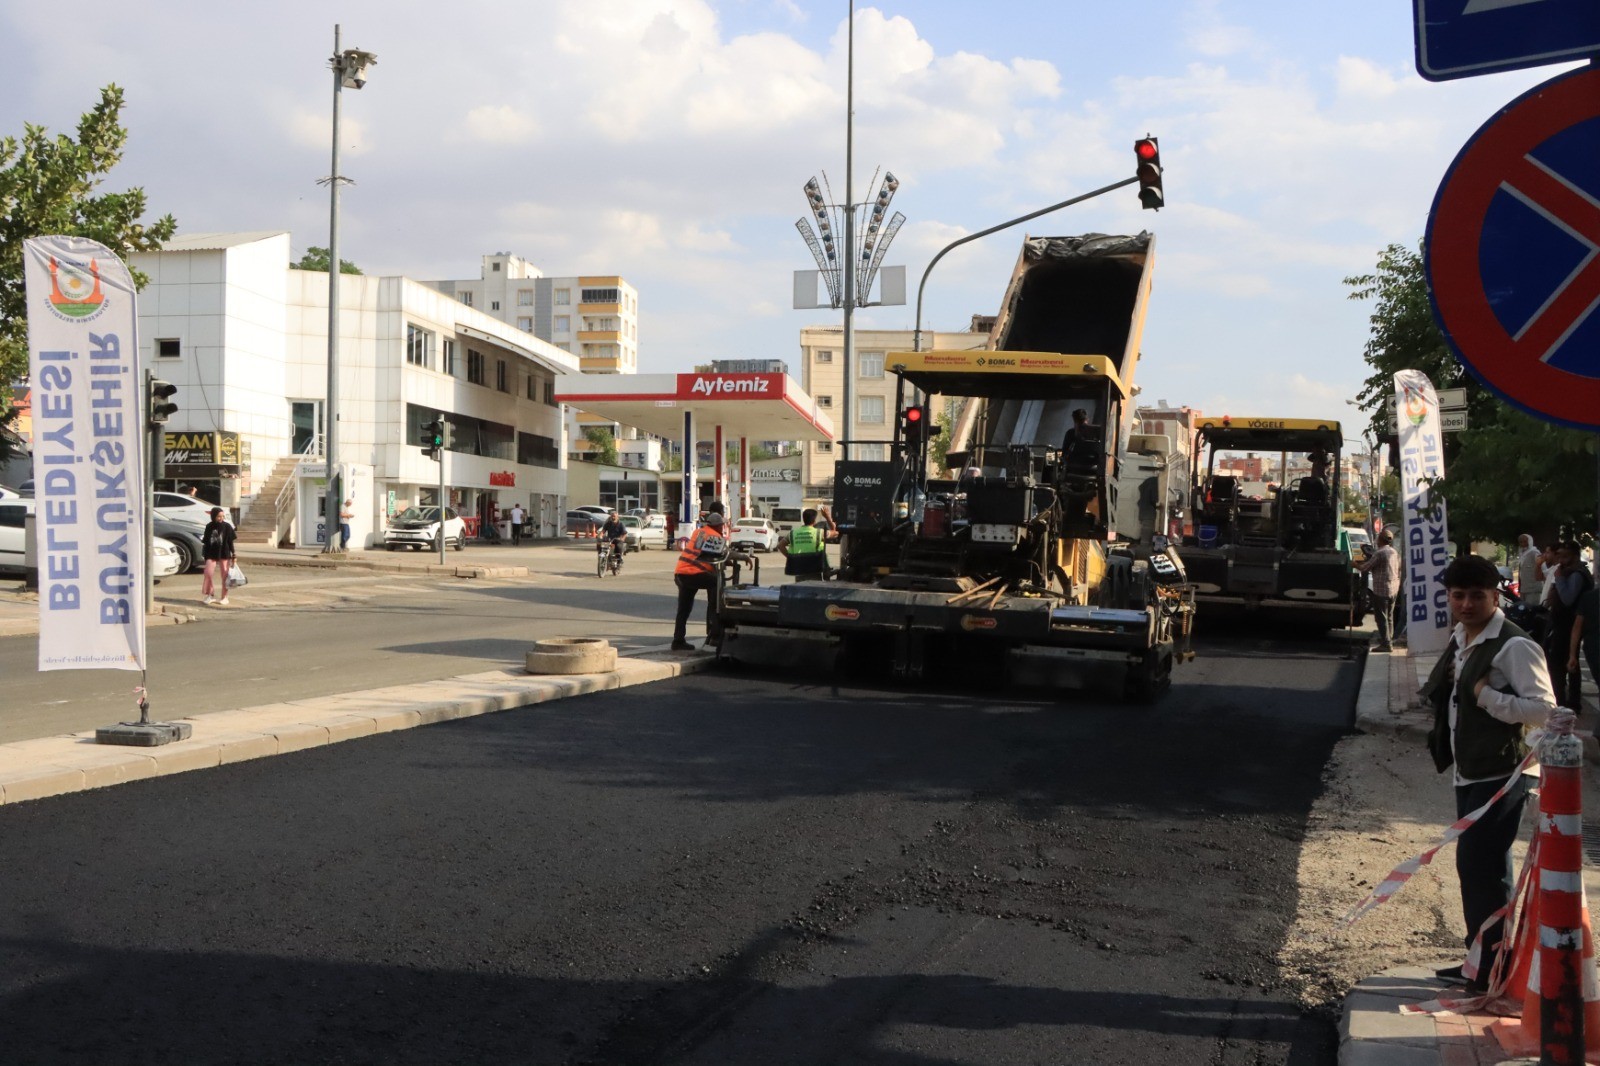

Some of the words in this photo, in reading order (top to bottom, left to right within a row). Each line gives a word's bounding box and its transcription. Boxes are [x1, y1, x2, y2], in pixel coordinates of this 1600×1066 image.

[988, 358, 1016, 366] BOMAG
[691, 377, 769, 396] Aytemiz
[1248, 419, 1285, 429] VÖGELE
[1441, 417, 1464, 426] ubesi
[854, 477, 882, 486] BOMAG
